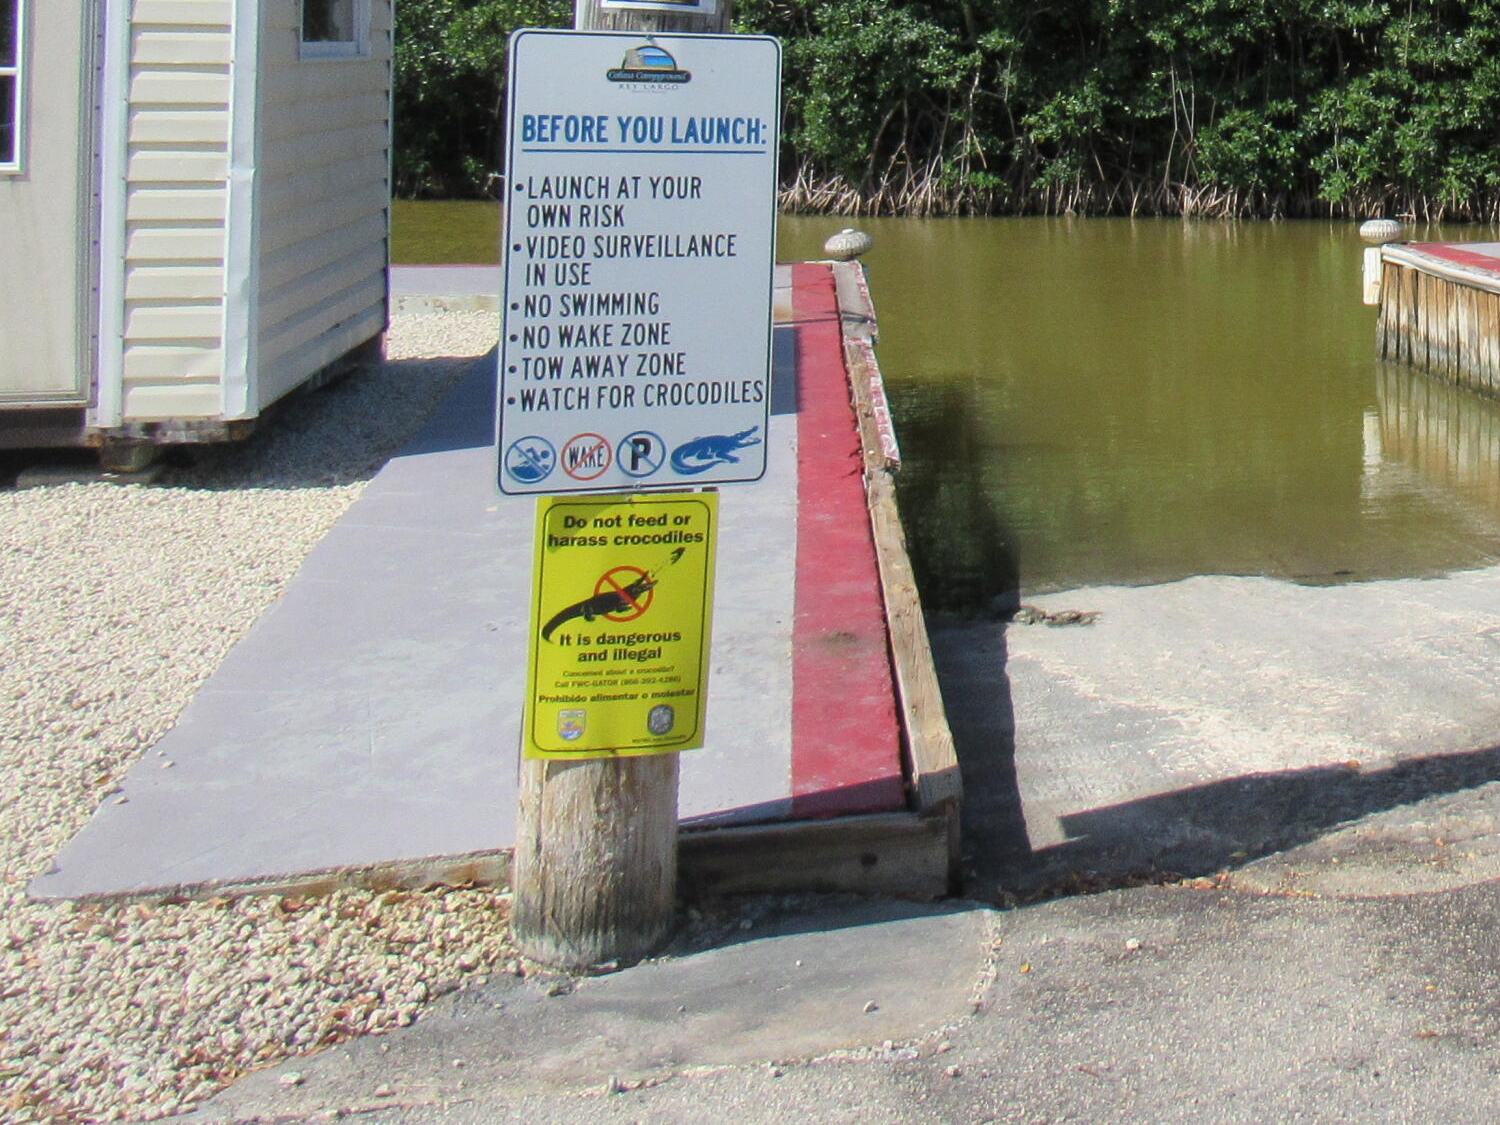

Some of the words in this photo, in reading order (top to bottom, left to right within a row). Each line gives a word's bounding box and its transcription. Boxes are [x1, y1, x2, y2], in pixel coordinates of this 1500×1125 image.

[522, 115, 609, 143] BEFORE
[617, 117, 664, 143] YOU
[672, 117, 767, 145] LAUNCH:
[528, 176, 609, 199] LAUNCH
[617, 177, 640, 198] AT
[650, 177, 702, 199] YOUR
[527, 205, 573, 227] OWN
[580, 205, 624, 227] RISK
[526, 236, 585, 258] VIDEO
[593, 235, 737, 258] SURVEILLANCE
[526, 264, 546, 286] IN
[554, 263, 591, 286] USE
[524, 294, 552, 317] NO
[560, 292, 660, 317] SWIMMING
[523, 325, 550, 349] NO
[558, 324, 613, 347] WAKE
[621, 323, 671, 346] ZONE
[522, 357, 564, 380] TOW
[570, 354, 629, 378] AWAY
[637, 353, 686, 376] ZONE
[520, 386, 589, 412] WATCH
[598, 385, 635, 409] FOR
[644, 380, 763, 406] CROCODILES
[569, 445, 604, 468] WAKE
[564, 515, 587, 528] Do
[593, 515, 621, 527] not
[628, 514, 667, 527] feed
[673, 514, 691, 525] or
[549, 534, 607, 547] harass
[614, 531, 703, 545] crocodiles
[560, 633, 572, 646] It
[577, 633, 591, 645] is
[596, 630, 681, 647] dangerous
[578, 649, 607, 662] and
[614, 647, 661, 663] illegal
[539, 694, 587, 703] Prohibido
[591, 692, 638, 702] alimentar
[651, 688, 695, 699] molestar
